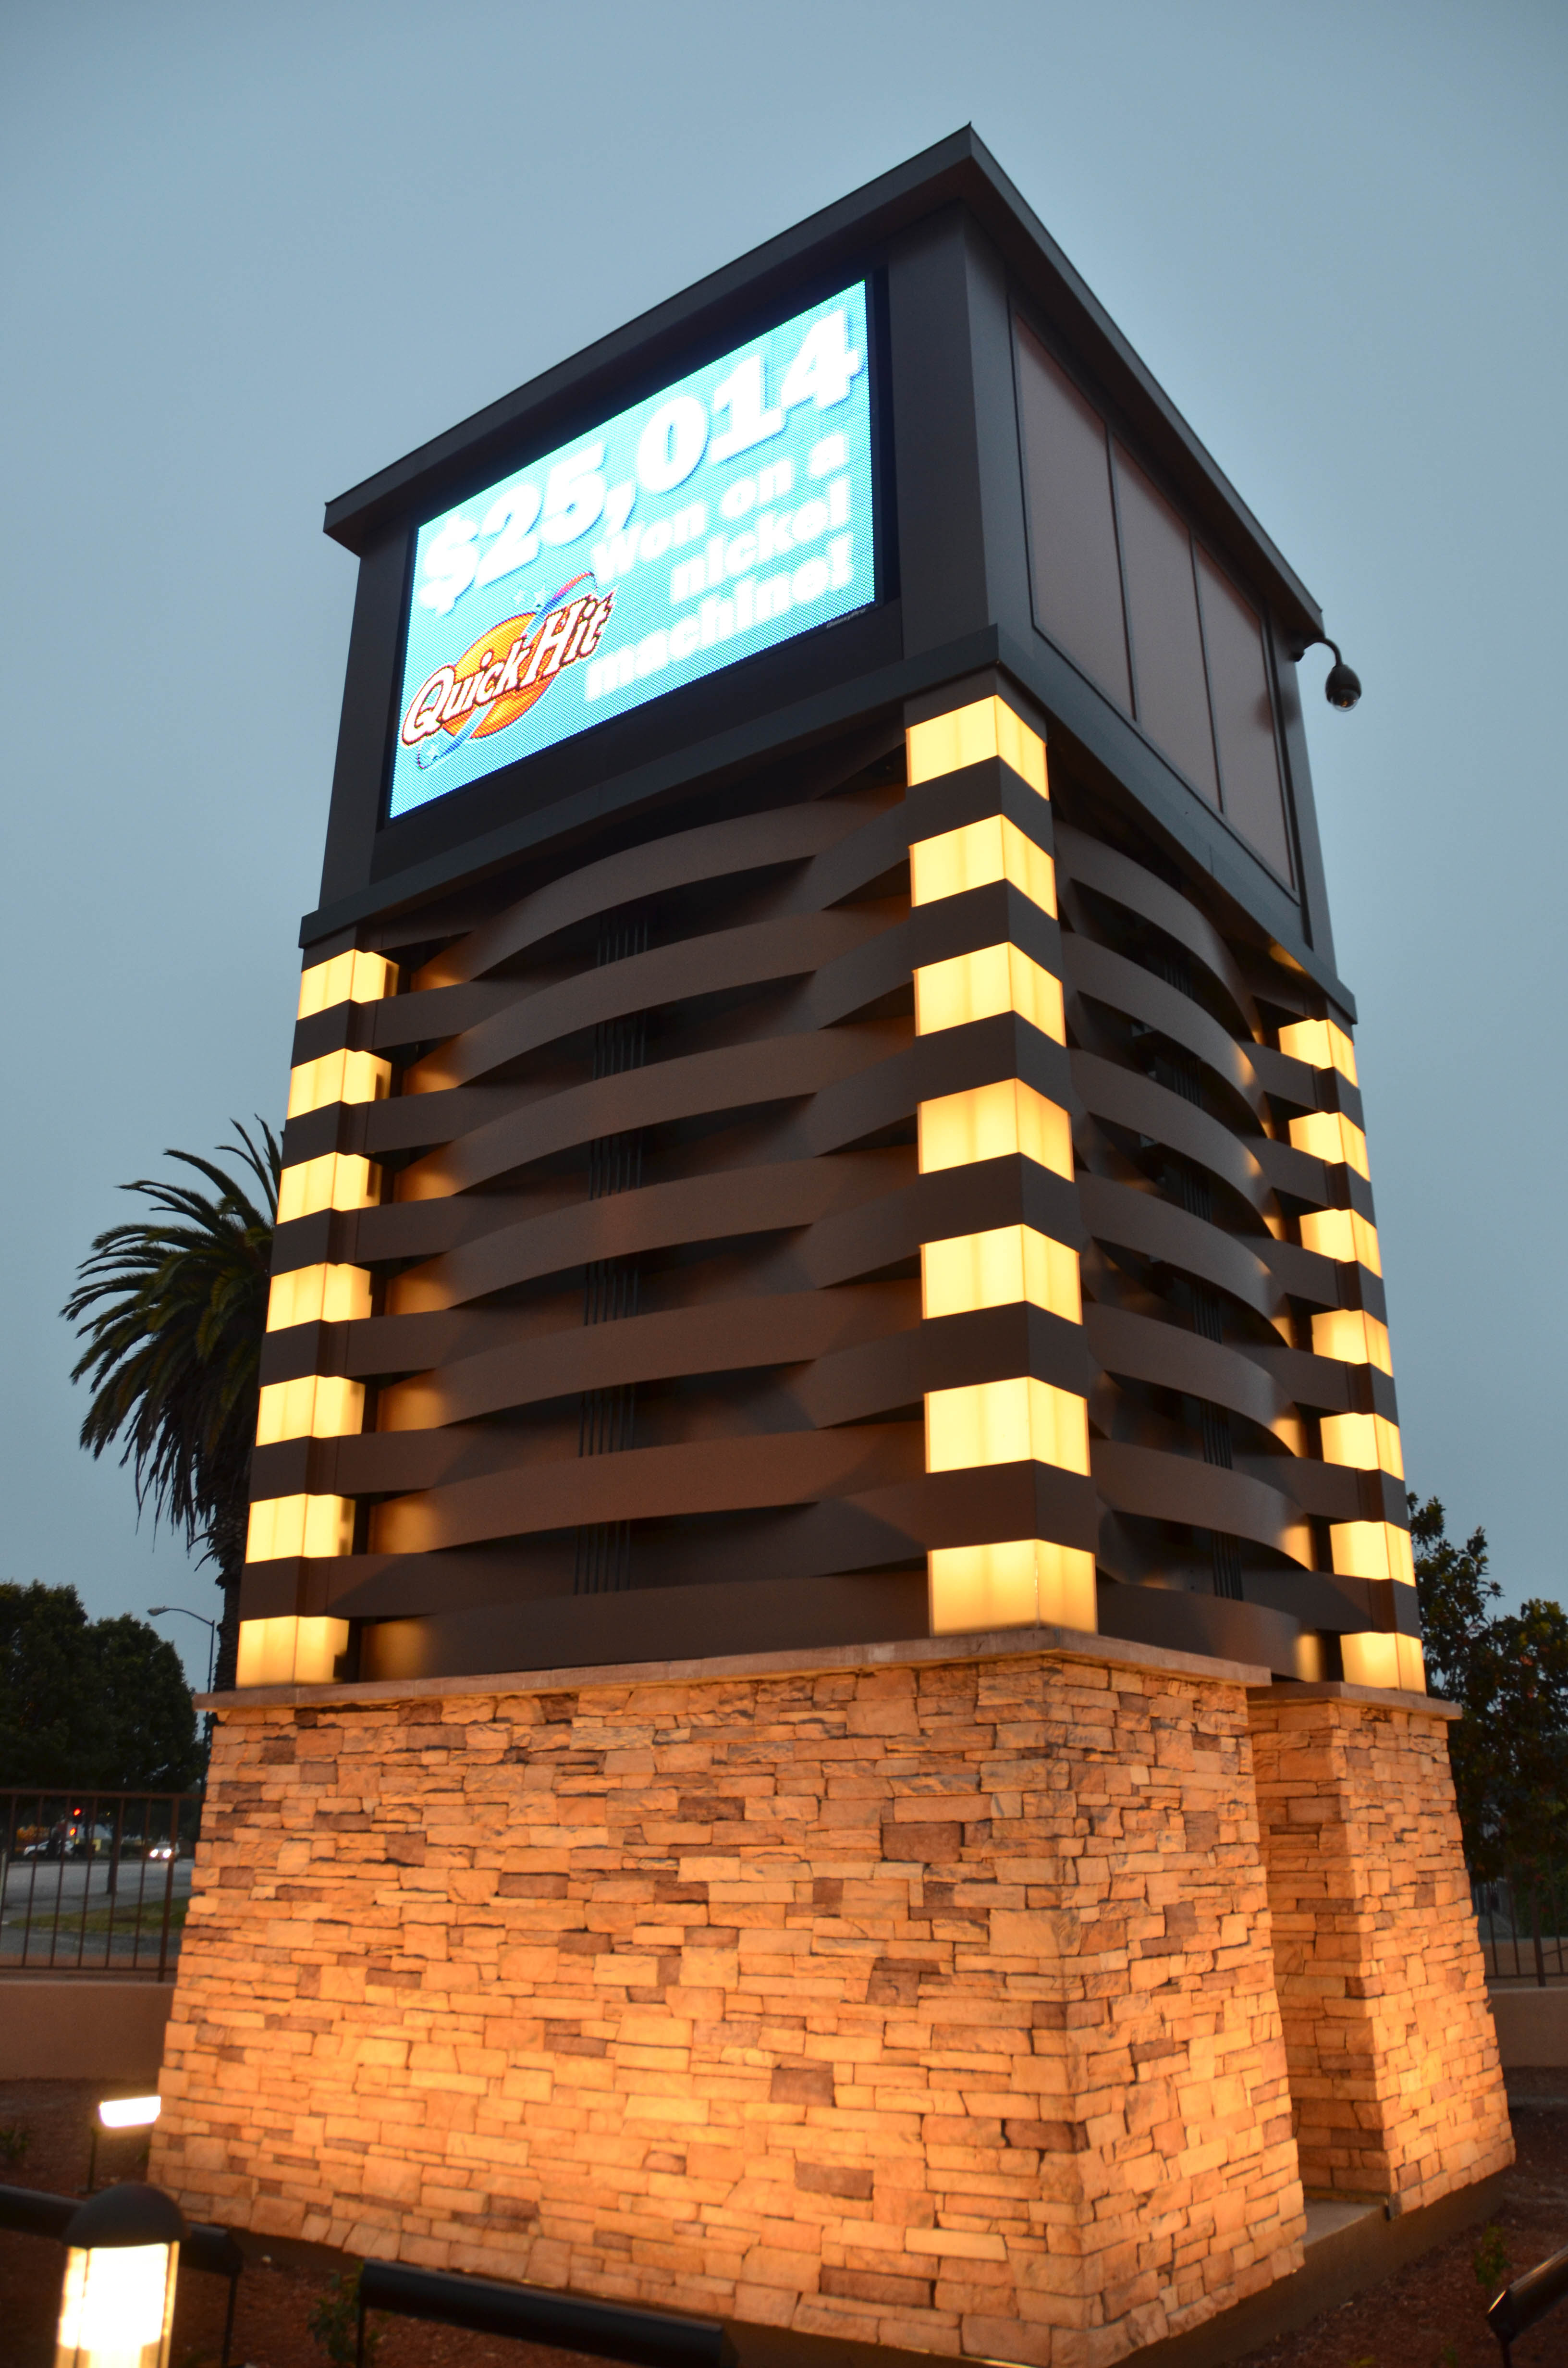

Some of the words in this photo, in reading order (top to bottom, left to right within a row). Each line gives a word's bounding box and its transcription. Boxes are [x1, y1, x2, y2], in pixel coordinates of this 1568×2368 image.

[417, 308, 860, 615] $25,014
[719, 457, 795, 520] on
[807, 429, 850, 479] a
[670, 474, 851, 605] nickel
[585, 532, 854, 703] machine!
